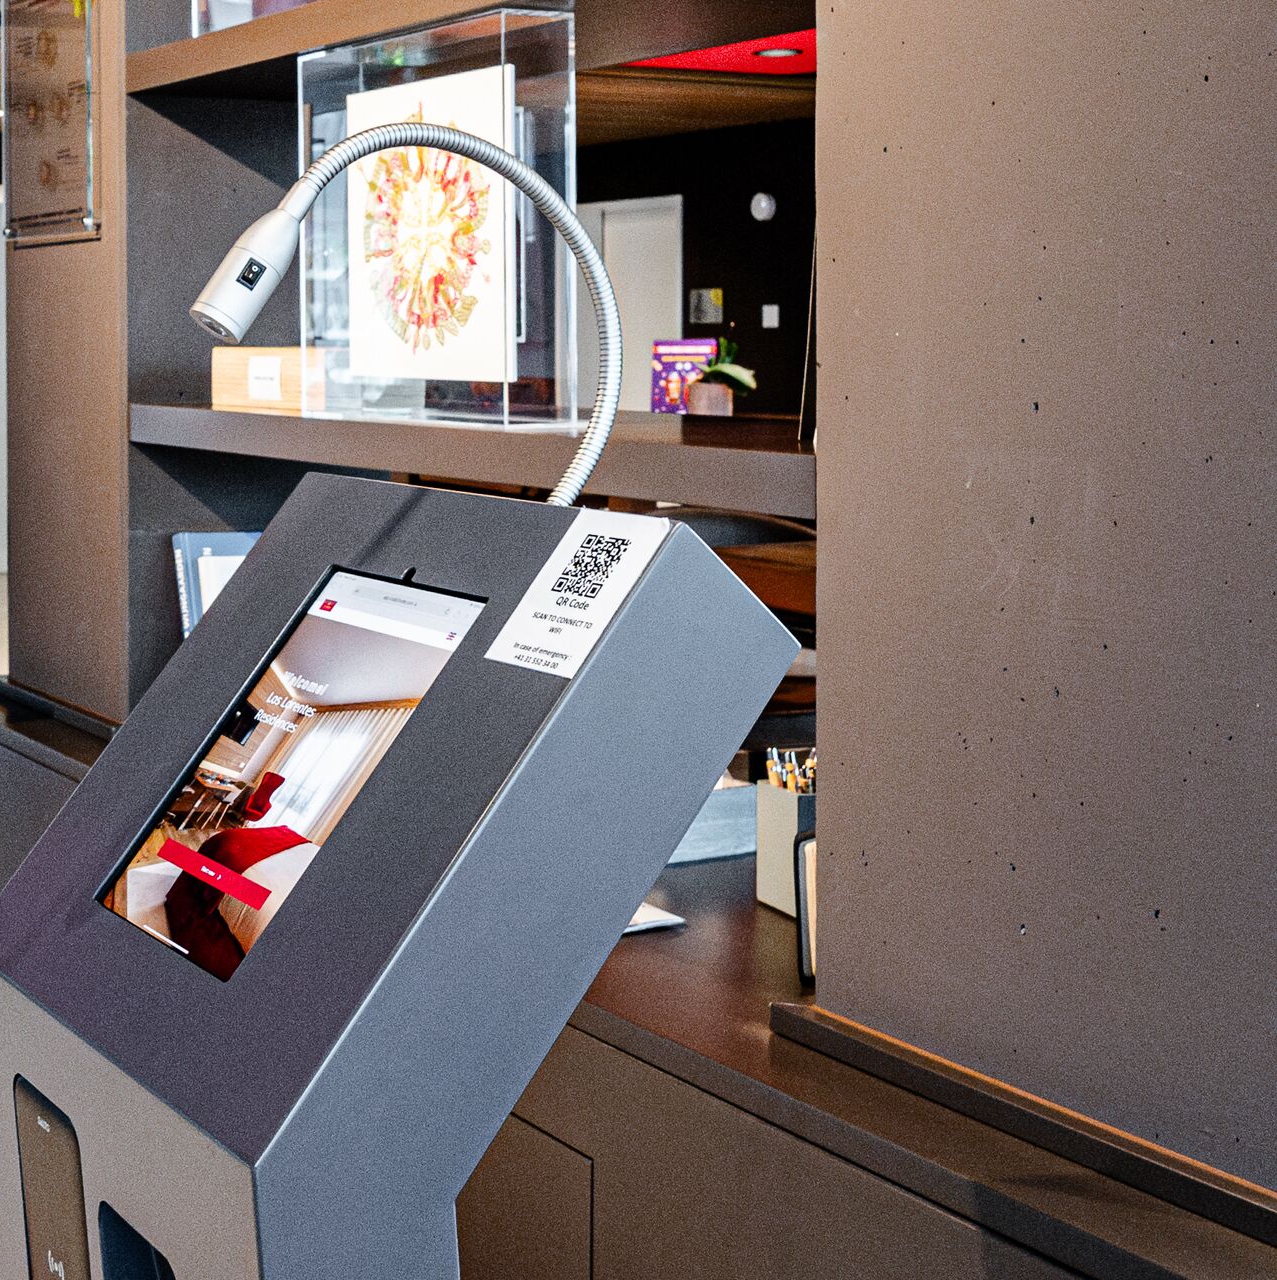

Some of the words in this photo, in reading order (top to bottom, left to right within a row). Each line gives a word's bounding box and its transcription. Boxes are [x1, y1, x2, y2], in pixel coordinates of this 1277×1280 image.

[555, 596, 569, 607] QR
[569, 598, 589, 610] Code
[532, 611, 547, 620] SCAN
[547, 613, 557, 622] TO
[557, 615, 584, 627] CONNECT
[584, 621, 593, 629] TO
[519, 644, 532, 652] case
[532, 645, 539, 653] of
[266, 691, 283, 707] Los
[281, 696, 317, 718] Lorentes
[254, 708, 298, 733] Residences
